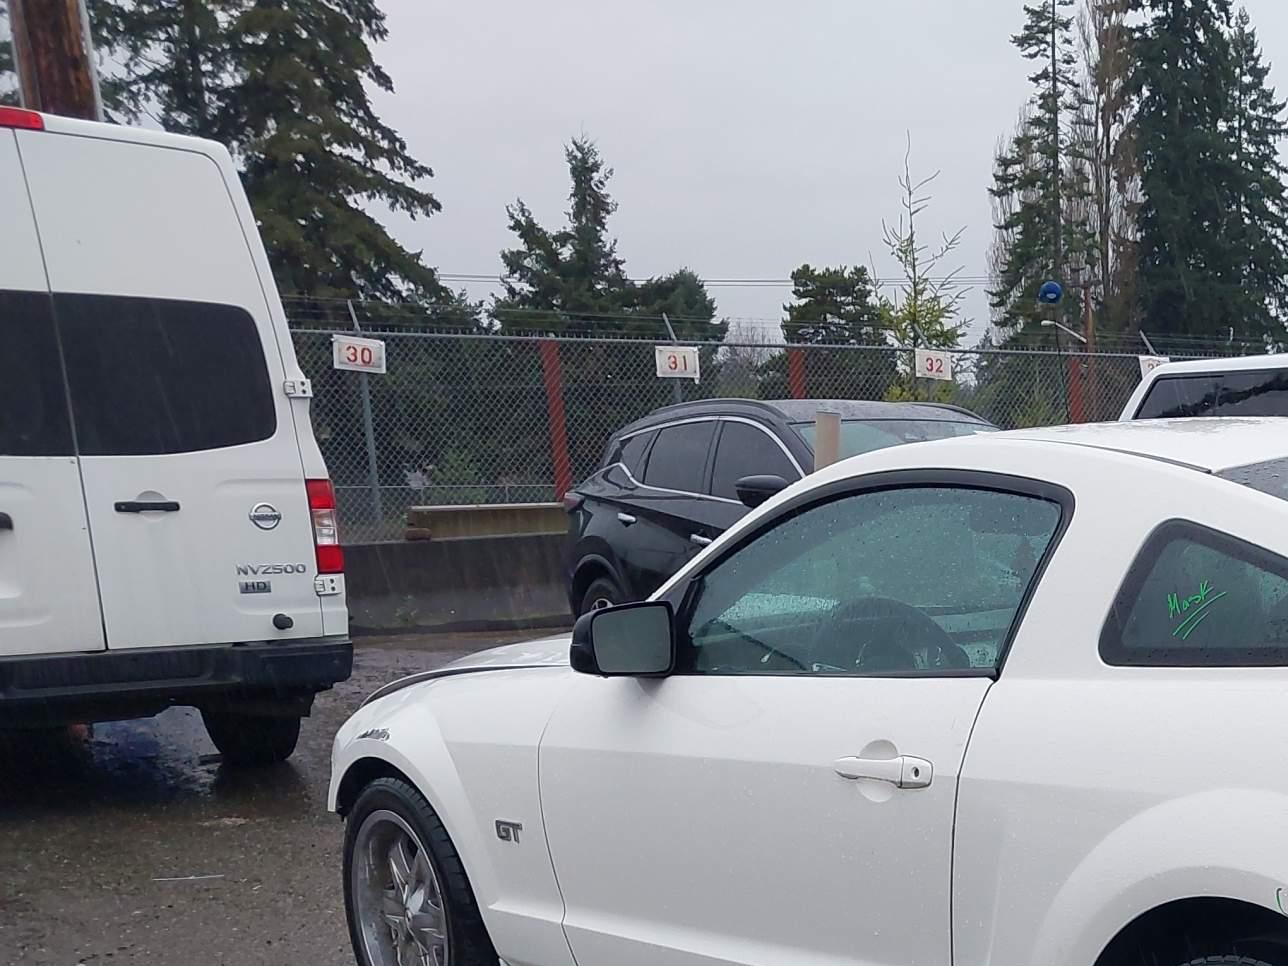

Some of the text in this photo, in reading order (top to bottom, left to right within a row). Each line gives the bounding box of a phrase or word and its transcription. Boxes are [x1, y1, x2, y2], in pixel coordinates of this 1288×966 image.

[346, 345, 372, 364] 30
[667, 354, 687, 371] 31
[926, 357, 943, 373] 32
[236, 563, 306, 576] NV2500
[244, 581, 267, 591] HD
[495, 819, 523, 844] GT
